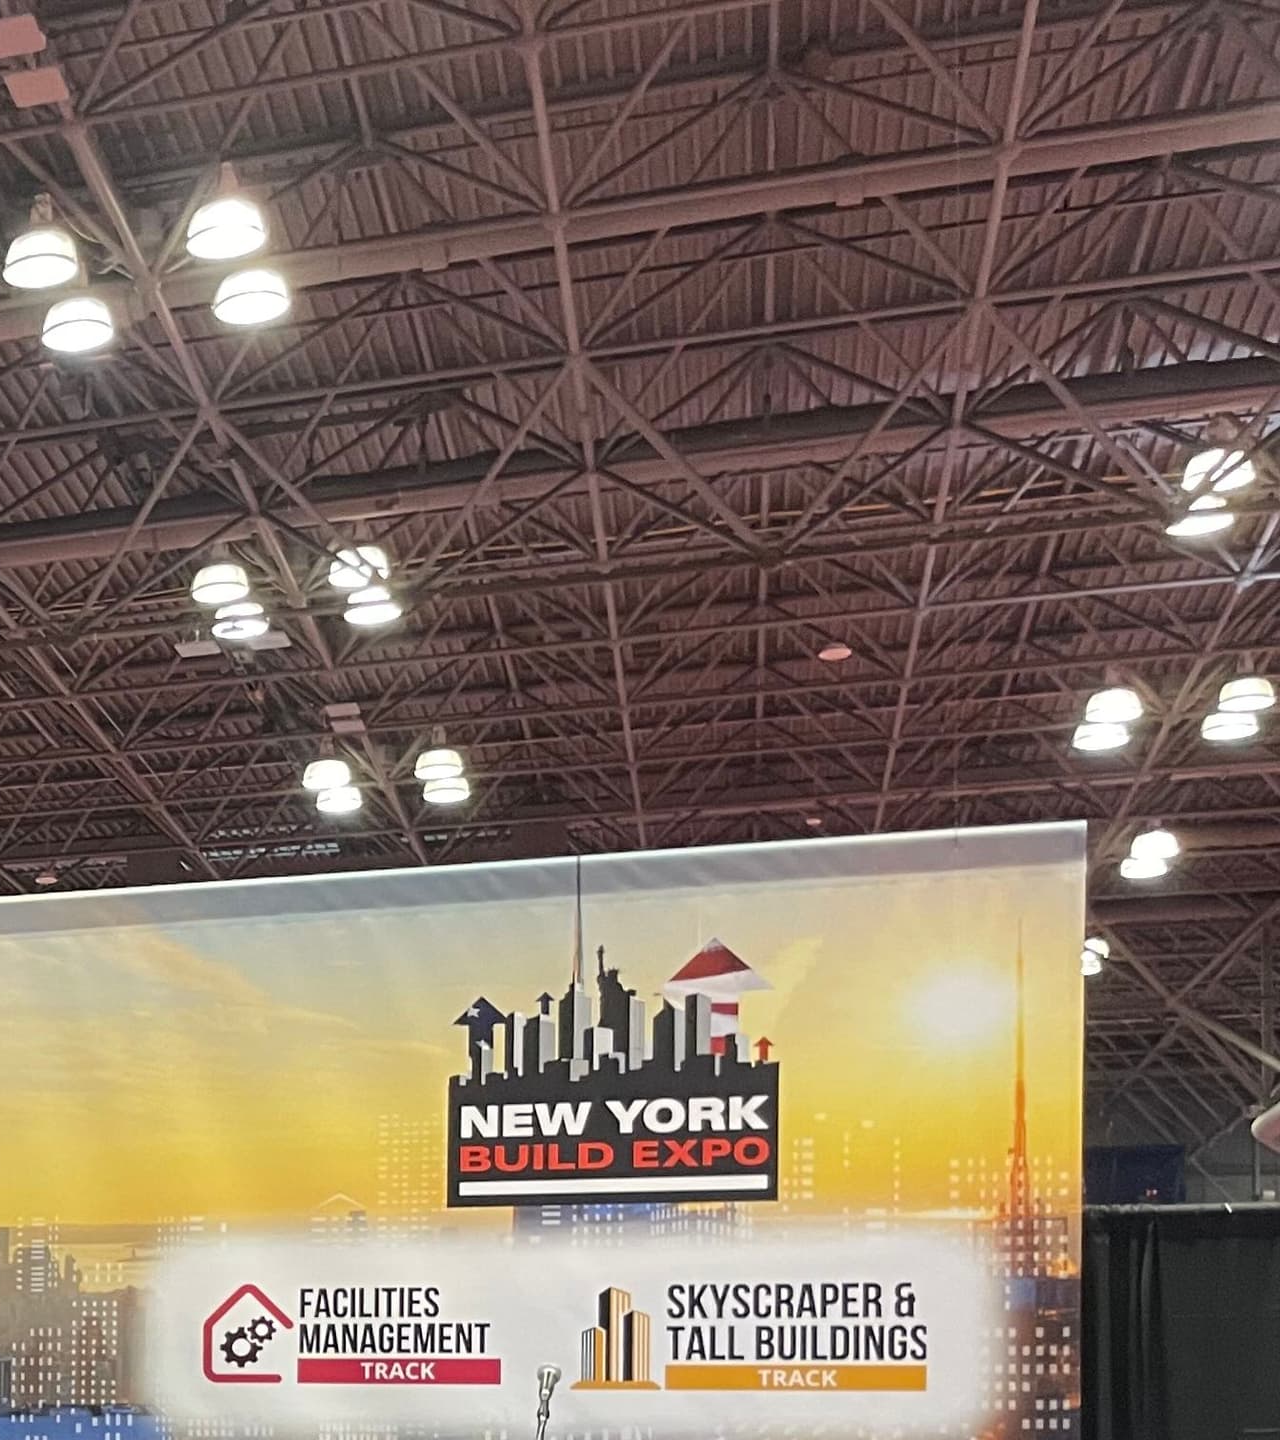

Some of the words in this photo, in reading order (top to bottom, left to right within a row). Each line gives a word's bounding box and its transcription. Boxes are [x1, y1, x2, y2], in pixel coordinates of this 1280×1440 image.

[460, 1101, 592, 1139] NEW
[605, 1095, 769, 1134] YORK
[459, 1141, 615, 1172] BUILD
[633, 1136, 770, 1169] EXPO
[299, 1287, 440, 1318] FACILITIES
[666, 1282, 883, 1319] SKYSCRAPER
[895, 1282, 916, 1318] &
[298, 1323, 490, 1354] MANAGEMENT
[666, 1325, 744, 1361] TALL
[755, 1324, 927, 1361] BUILDINGS
[361, 1362, 436, 1380] TRACK
[757, 1369, 838, 1387] TRACK
